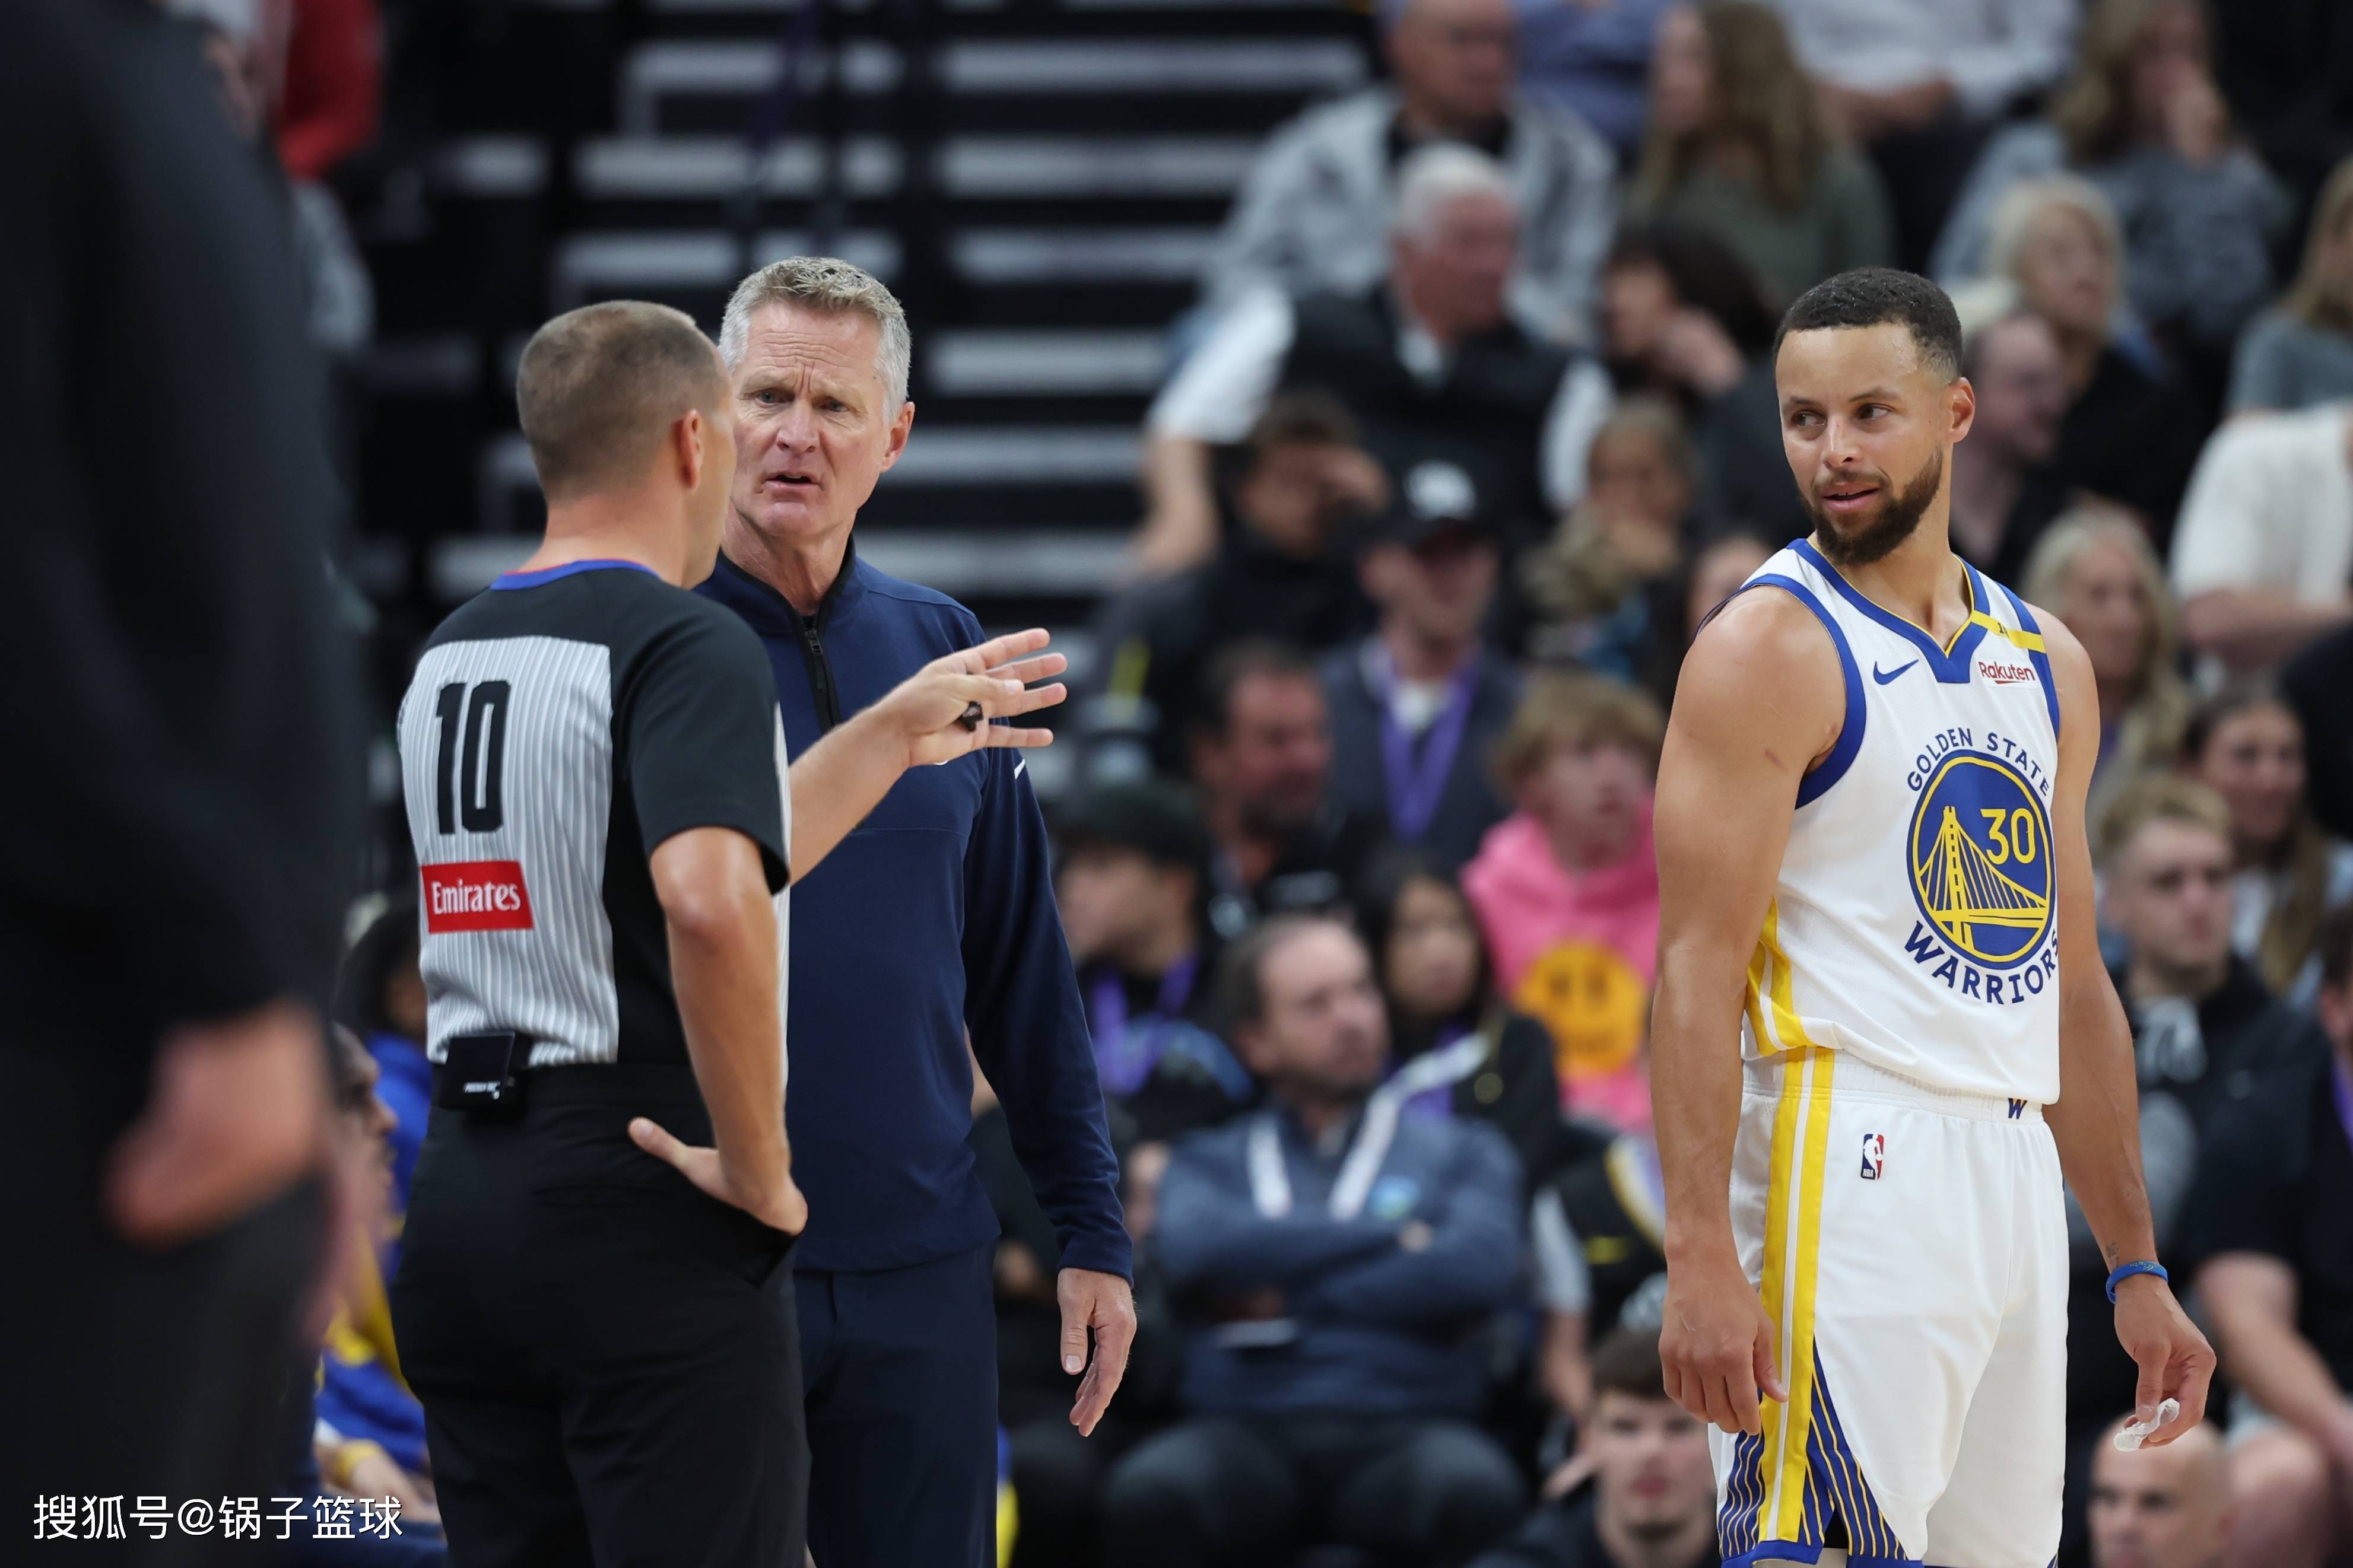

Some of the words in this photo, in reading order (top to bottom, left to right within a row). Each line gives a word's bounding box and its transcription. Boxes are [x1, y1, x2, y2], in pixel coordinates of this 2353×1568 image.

[1978, 661, 2036, 681] Rakuten
[436, 680, 511, 836] 10
[1907, 727, 1973, 791] GOLDEN
[1987, 732, 2049, 796] STATE
[1980, 807, 2036, 865] 30
[431, 879, 521, 915] Emirates
[1904, 920, 2058, 1005] WARRIORS
[1862, 1168, 1873, 1178] NBA
